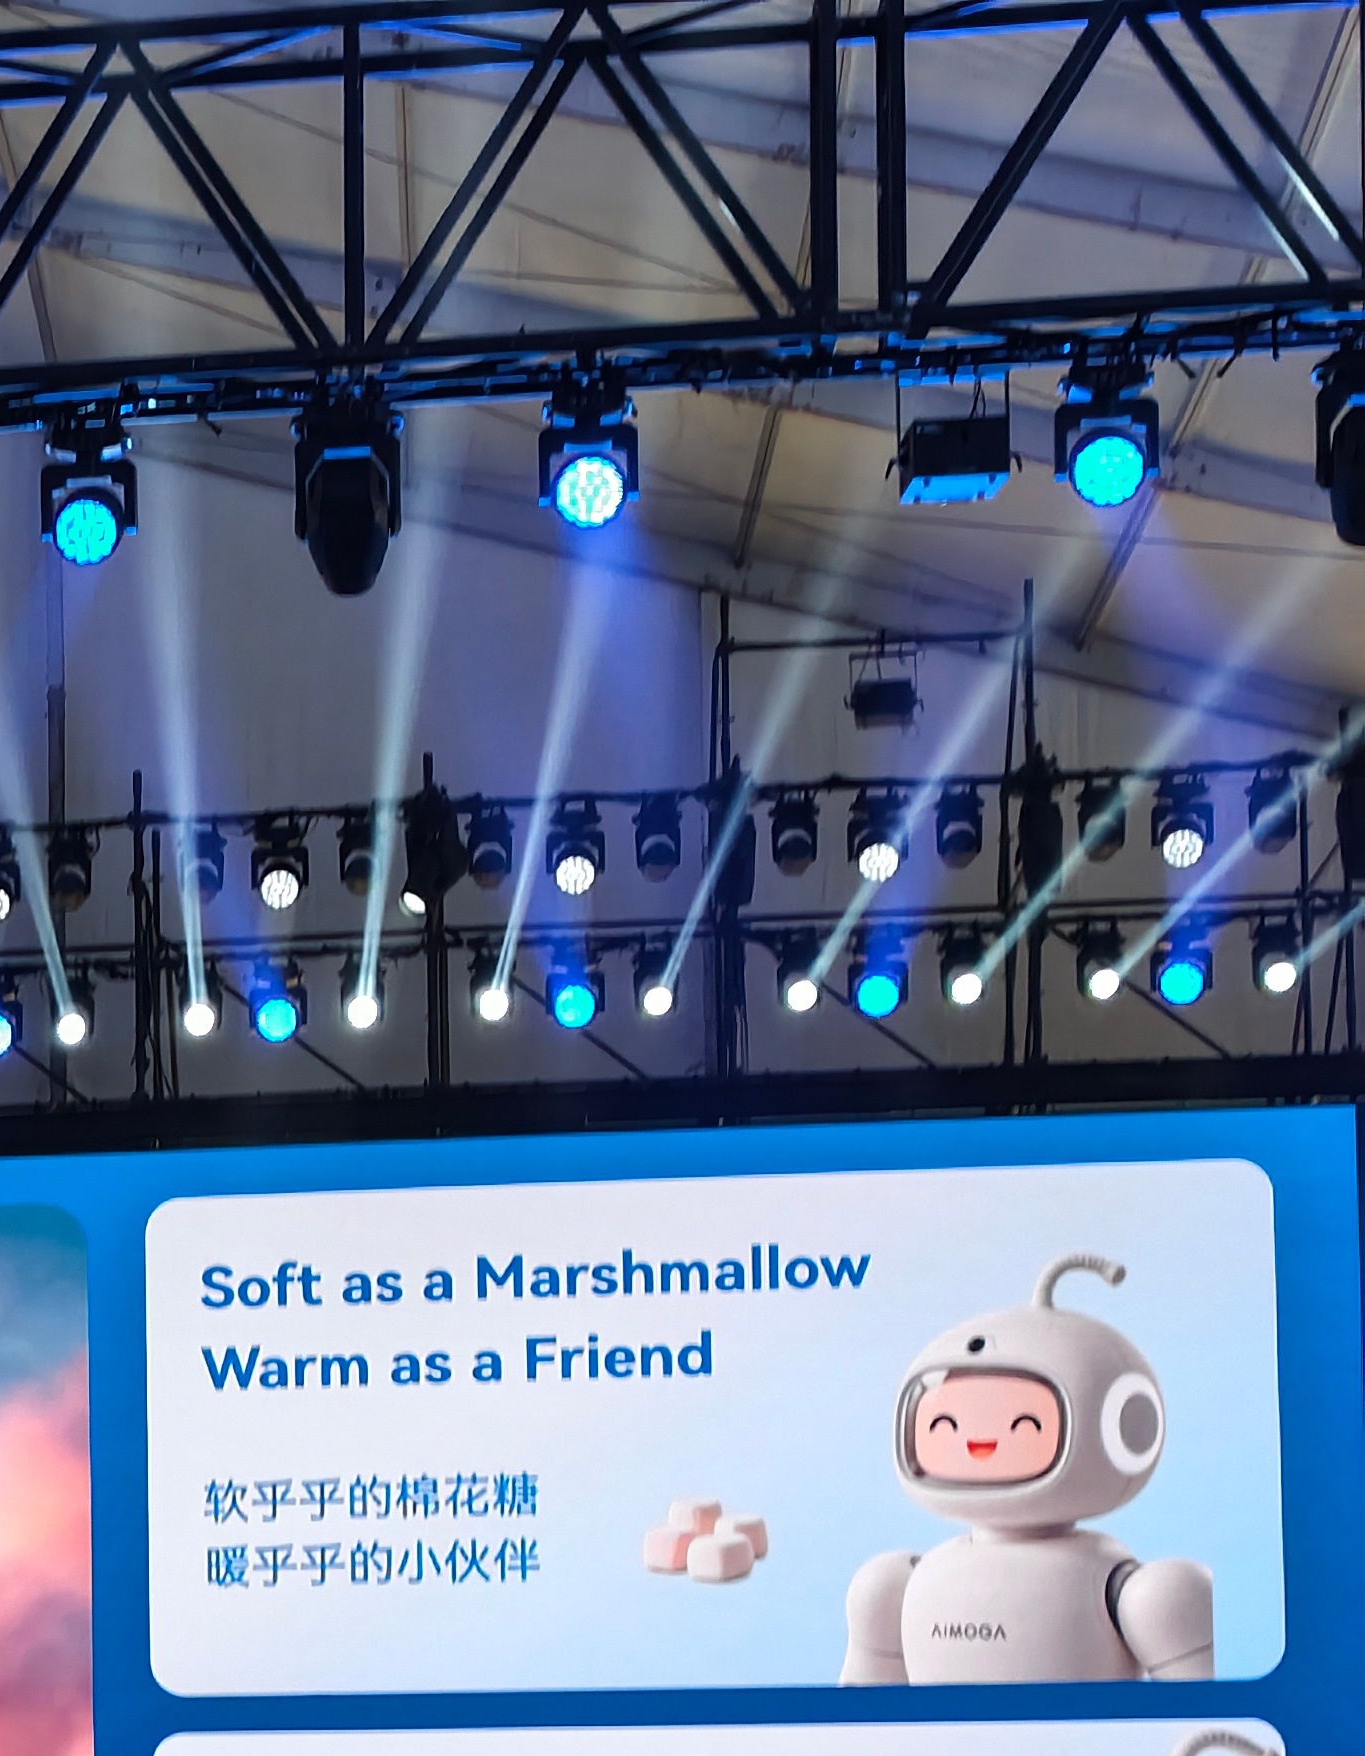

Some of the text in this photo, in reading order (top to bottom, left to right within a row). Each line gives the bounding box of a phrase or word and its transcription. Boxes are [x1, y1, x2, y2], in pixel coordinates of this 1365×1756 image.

[200, 1242, 872, 1310] Soft as a Marshmallow
[200, 1329, 713, 1391] Warm as a Friend
[204, 1470, 539, 1525] 软乎乎的棉花糖
[206, 1536, 541, 1588] 暖乎乎的小伙伴
